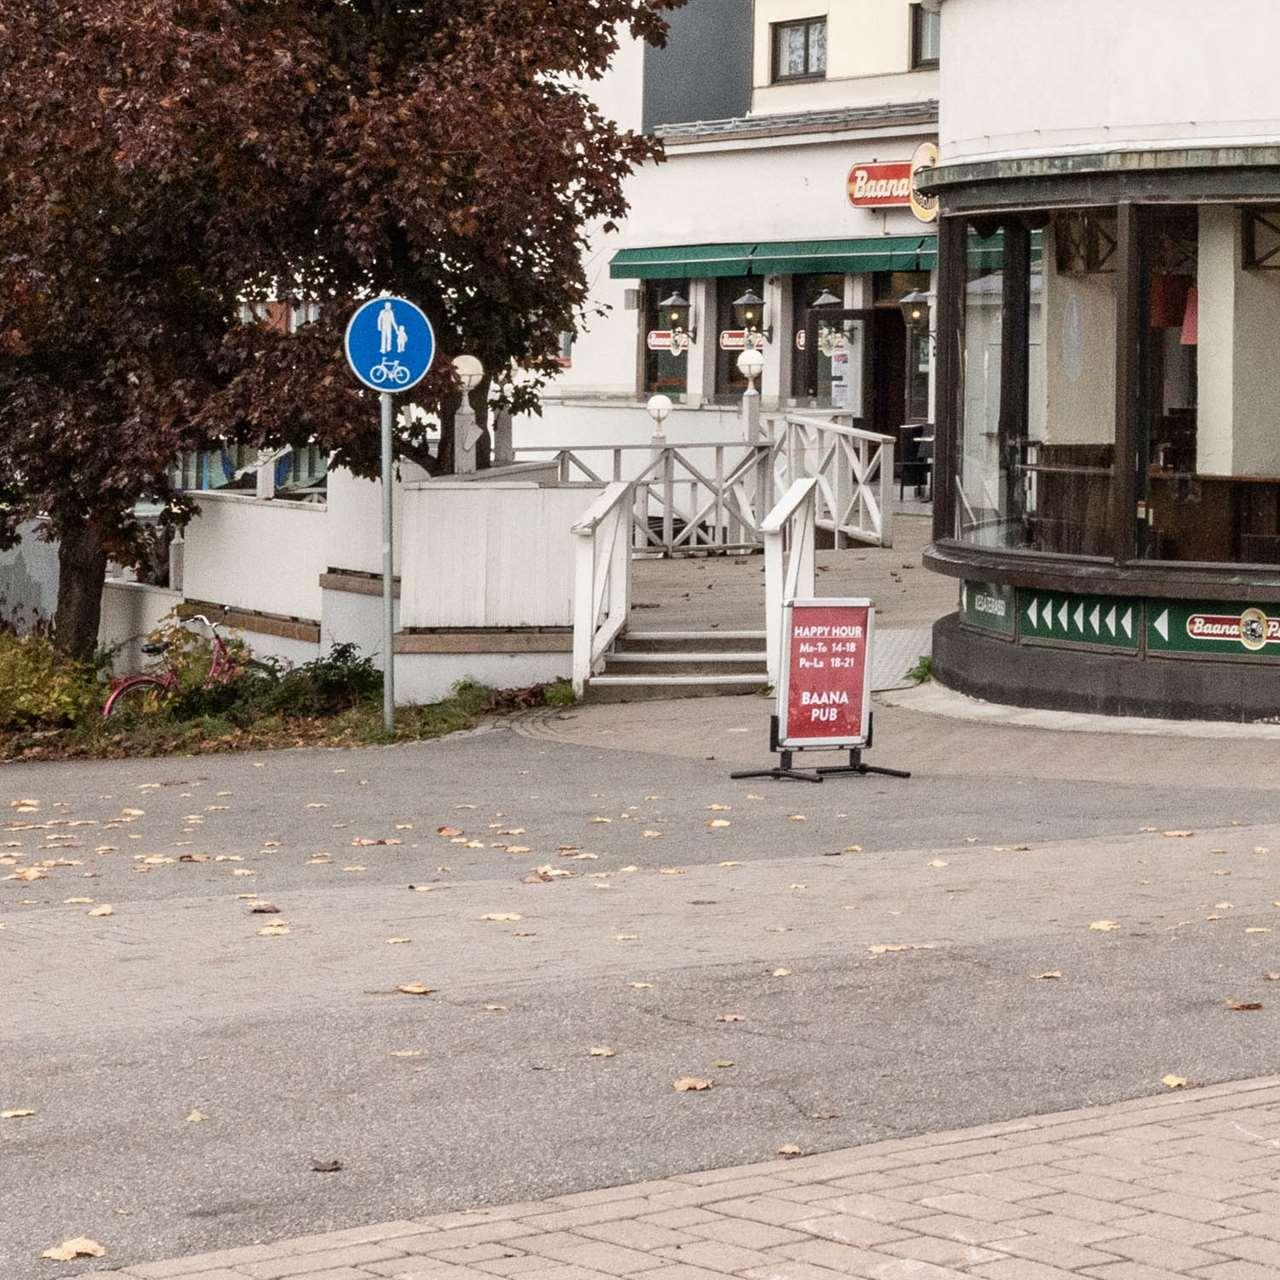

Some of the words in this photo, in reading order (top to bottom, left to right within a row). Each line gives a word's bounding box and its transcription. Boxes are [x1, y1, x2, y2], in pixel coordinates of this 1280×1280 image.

[853, 169, 911, 199] Baana
[794, 626, 829, 637] HAPPY
[832, 626, 863, 637] HOUR
[1193, 618, 1240, 635] Baana
[832, 642, 856, 653] 14-18
[831, 657, 854, 668] 18-21
[802, 692, 849, 705] BAANA
[811, 708, 838, 721] PUB
